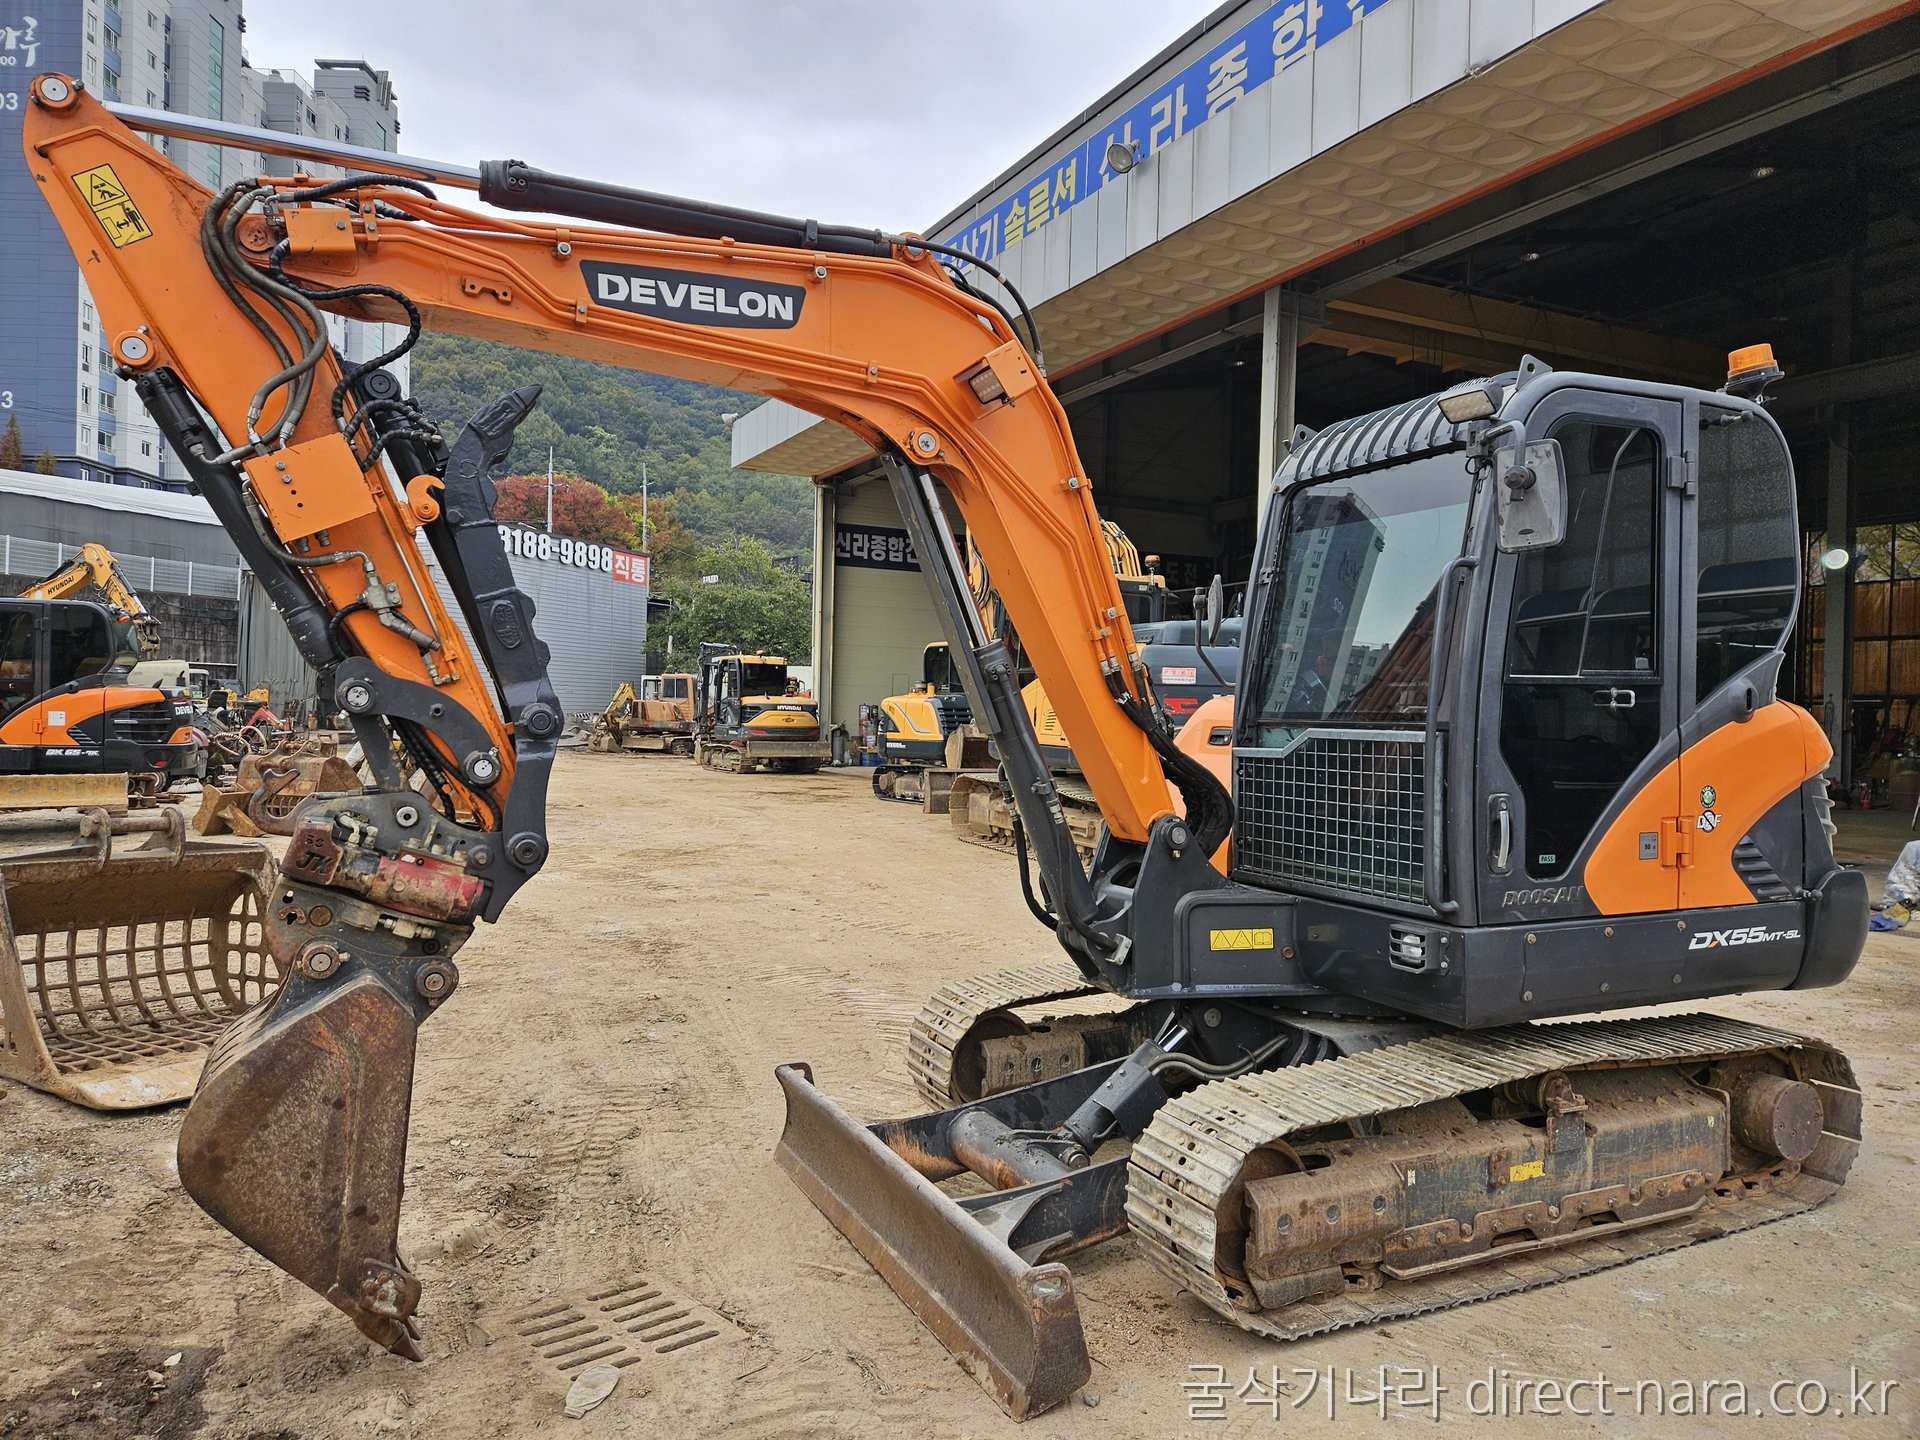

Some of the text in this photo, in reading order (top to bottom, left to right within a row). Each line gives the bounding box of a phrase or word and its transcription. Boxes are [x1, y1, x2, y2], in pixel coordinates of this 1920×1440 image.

[1004, 157, 1077, 251] 솔루션
[597, 272, 794, 322] DEVELON
[615, 553, 646, 584] 직통
[47, 575, 75, 595] HYUNDAI
[1540, 855, 1554, 863] PASS
